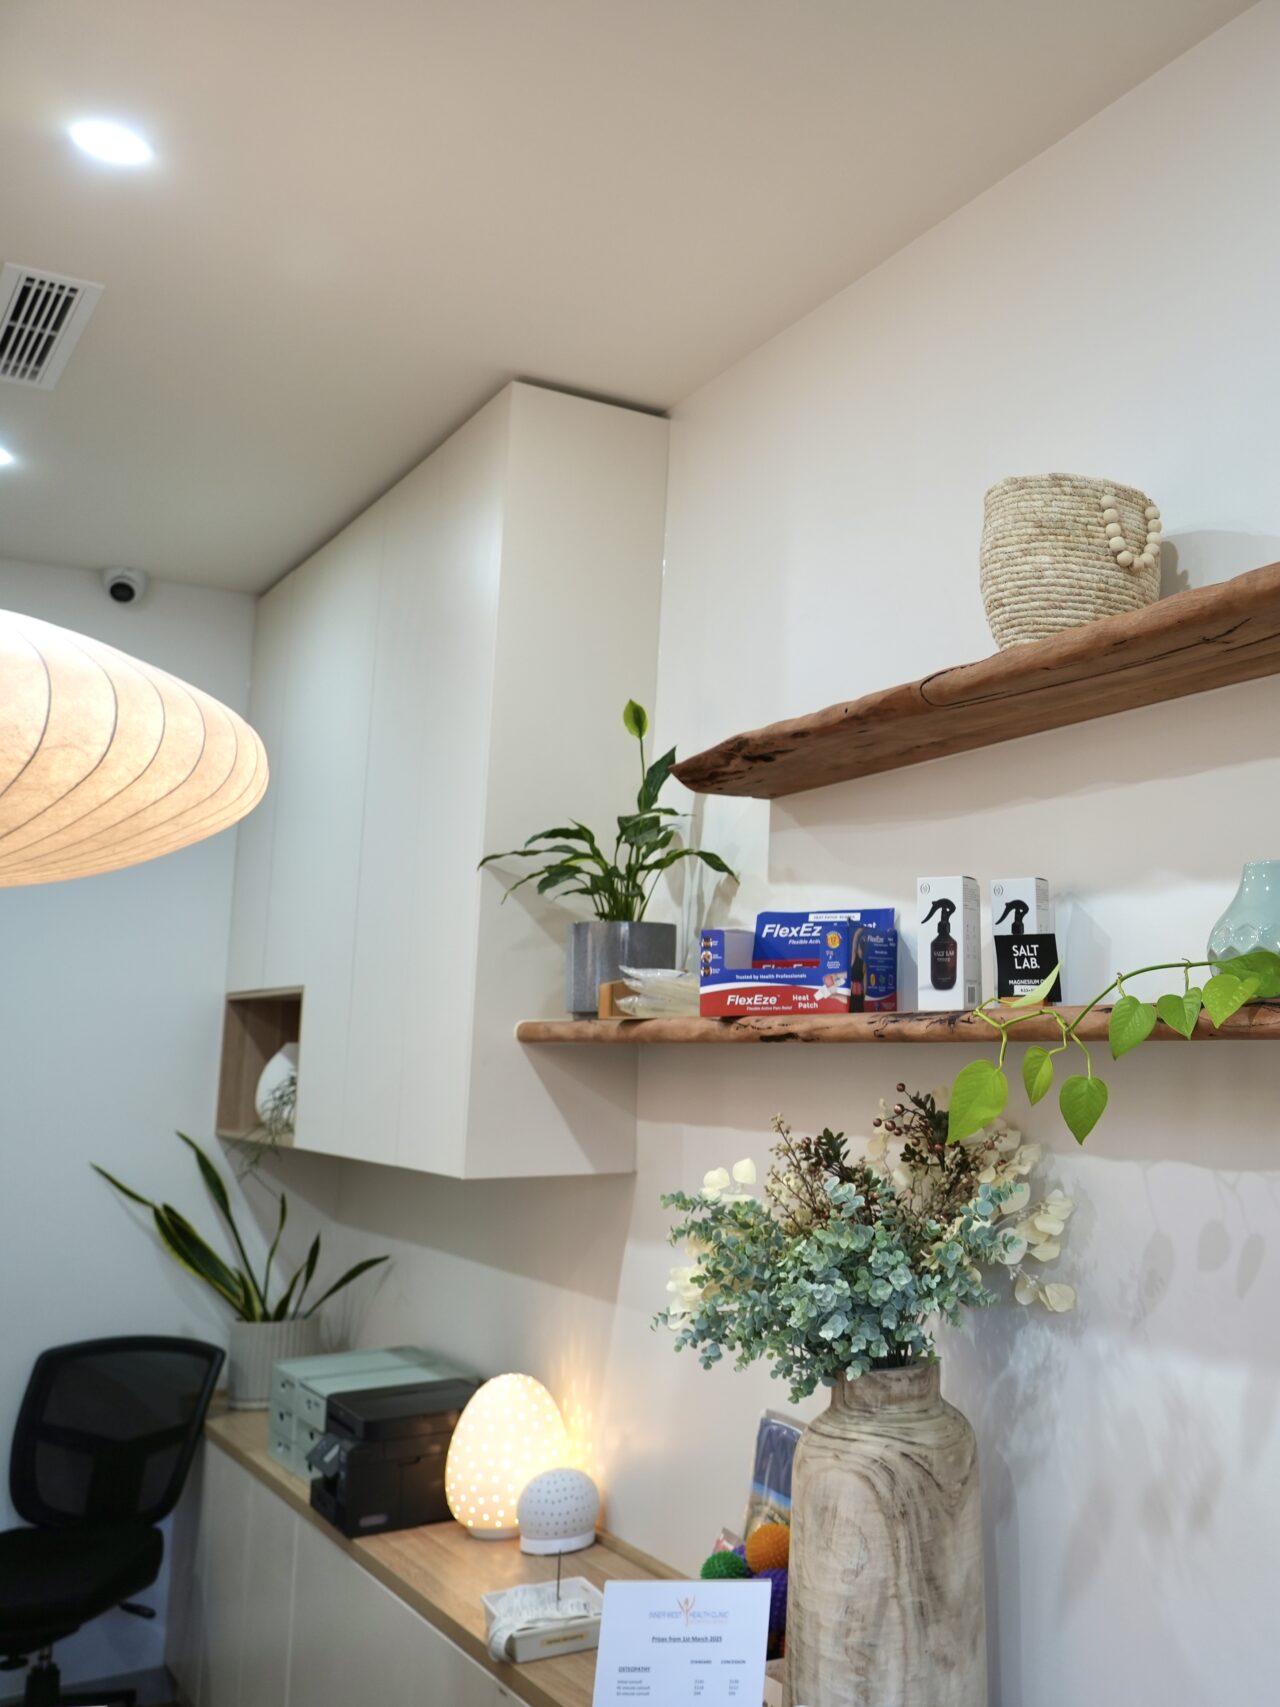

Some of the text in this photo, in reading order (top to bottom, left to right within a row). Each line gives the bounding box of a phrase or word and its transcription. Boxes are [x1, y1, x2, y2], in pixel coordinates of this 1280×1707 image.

[761, 922, 822, 938] FlexEz
[1012, 945, 1039, 957] SALT
[1014, 957, 1040, 969] LAB.
[727, 994, 777, 1006] FlexEze
[668, 1635, 681, 1643] from
[691, 1635, 708, 1643] March
